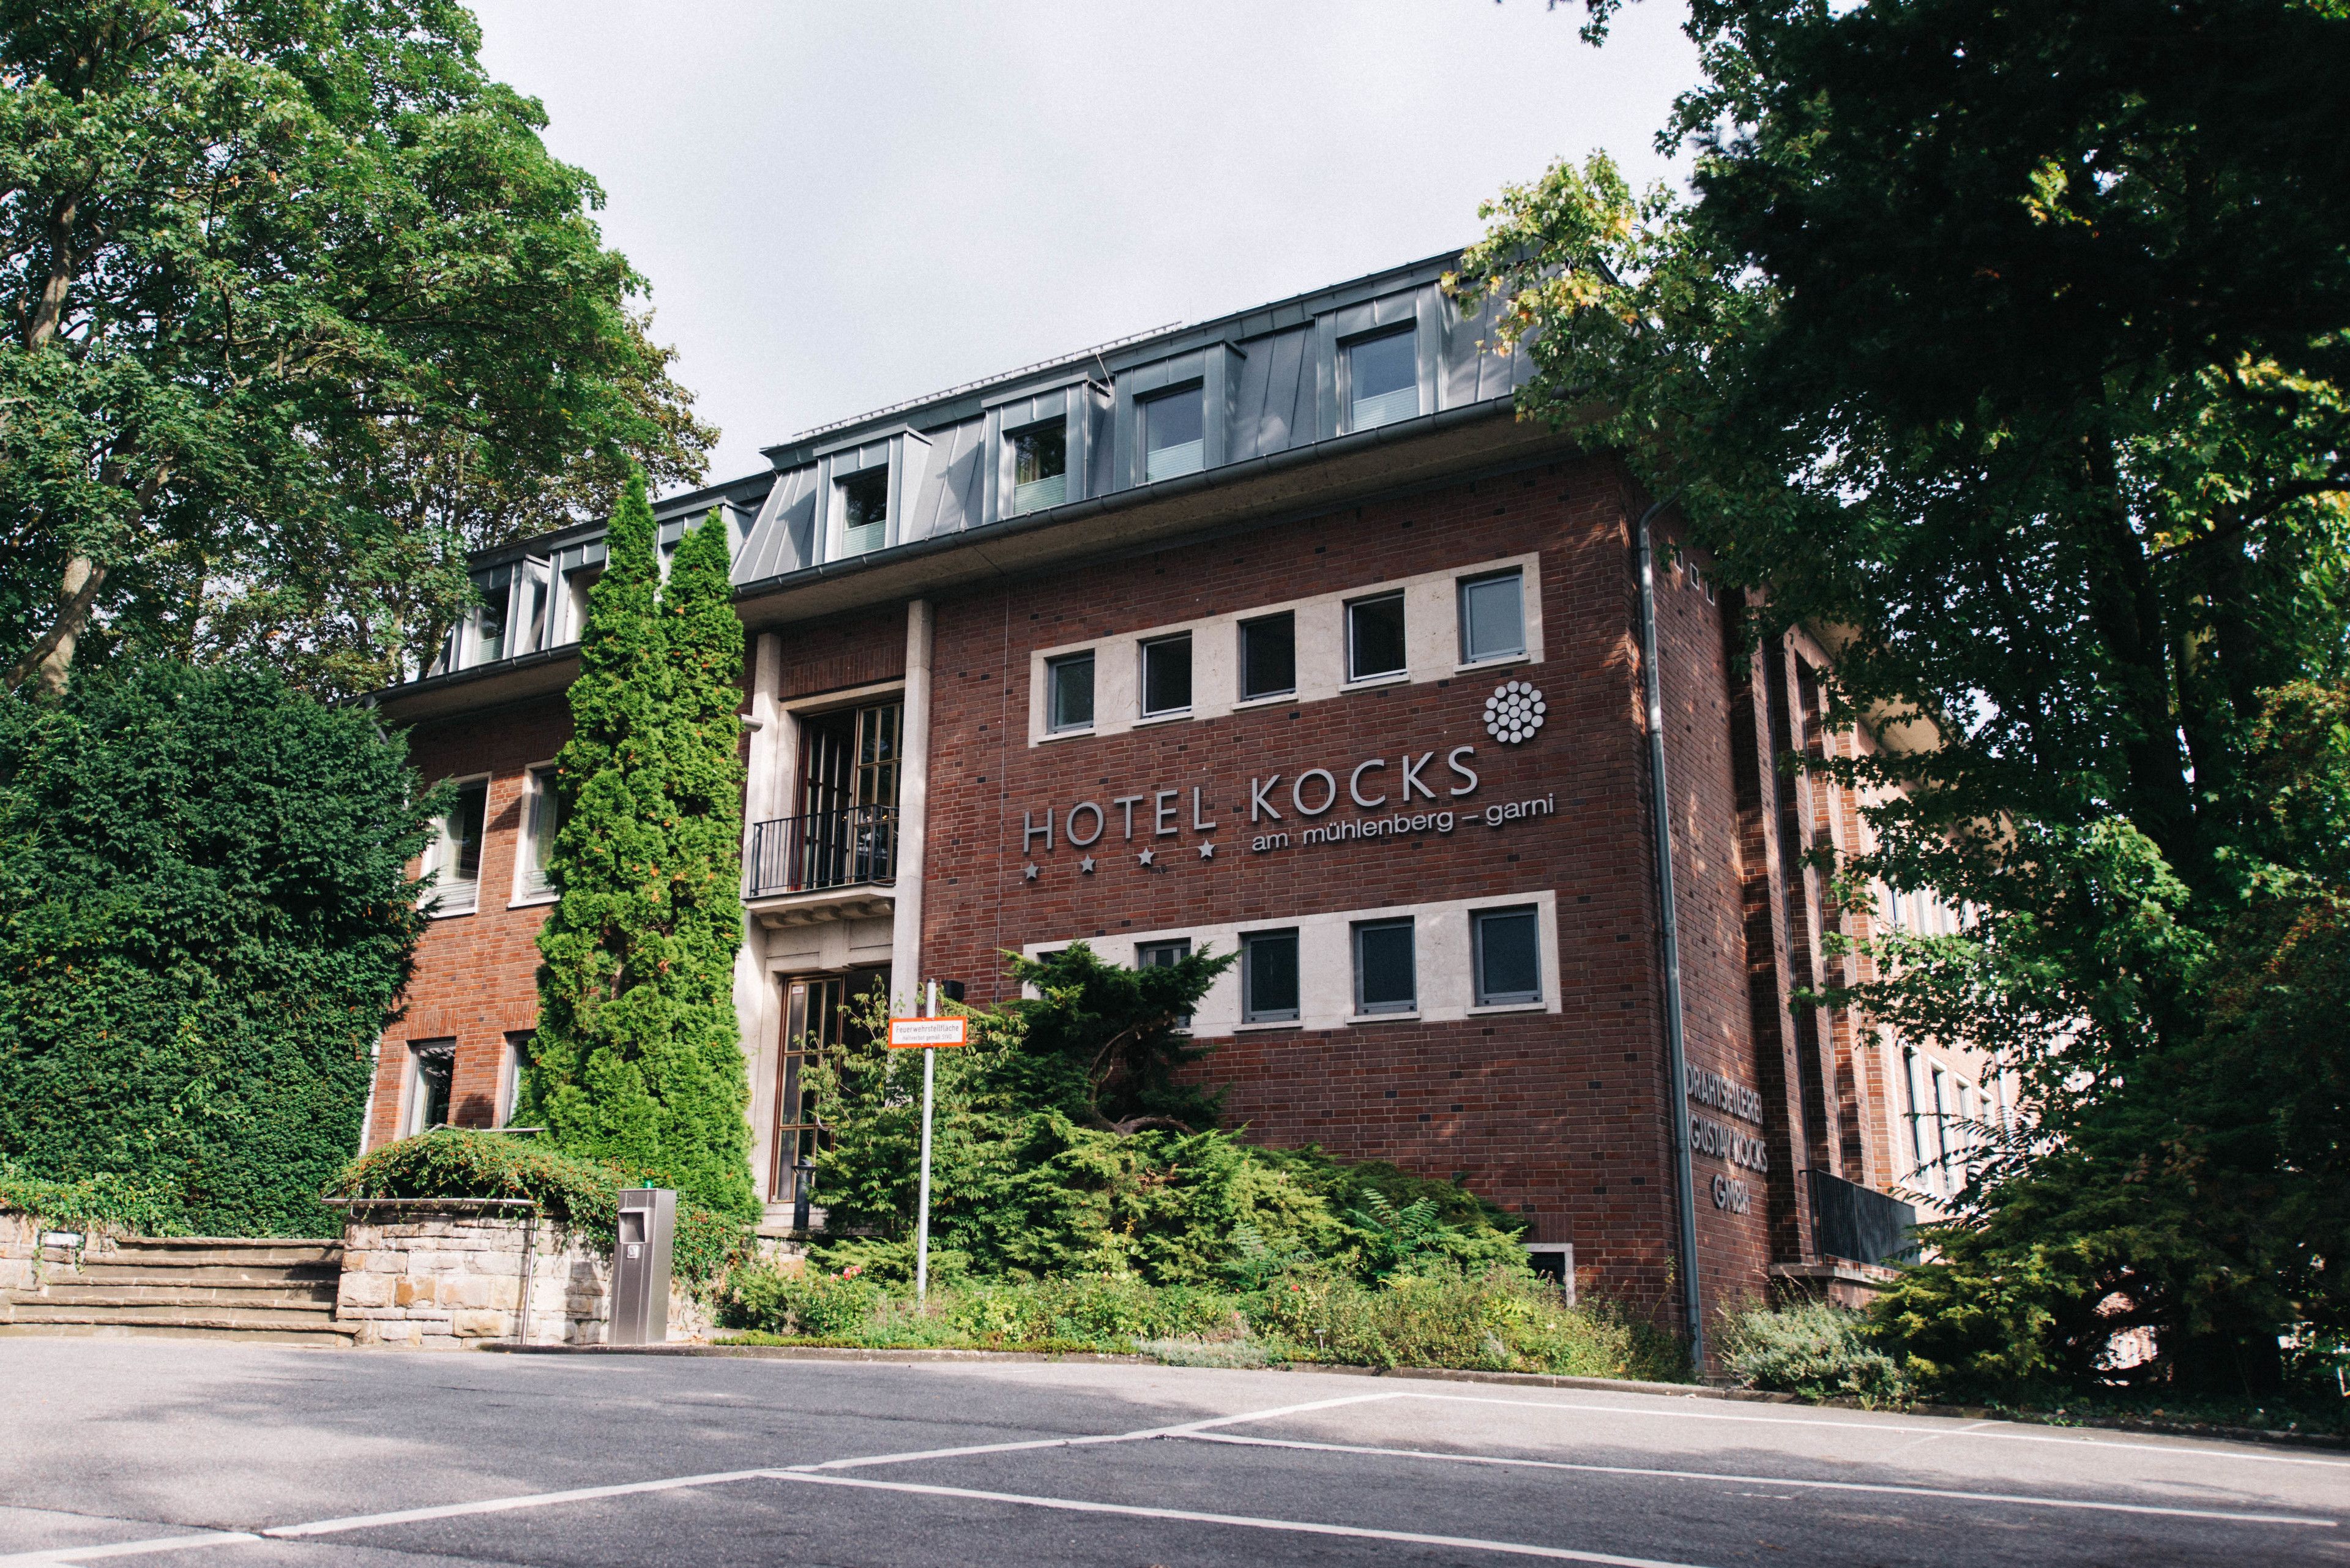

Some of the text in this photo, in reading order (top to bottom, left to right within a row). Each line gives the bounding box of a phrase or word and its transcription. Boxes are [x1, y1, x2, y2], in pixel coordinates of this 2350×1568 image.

[1023, 746, 1478, 853] HOTEL KOCKS
[1252, 832, 1288, 851] am
[1304, 811, 1453, 844] mühlenberg
[1486, 793, 1554, 826] garni
[1686, 1063, 1763, 1124] DRAHTSEILEREI
[1689, 1114, 1767, 1173] GUSTAV KOCKS
